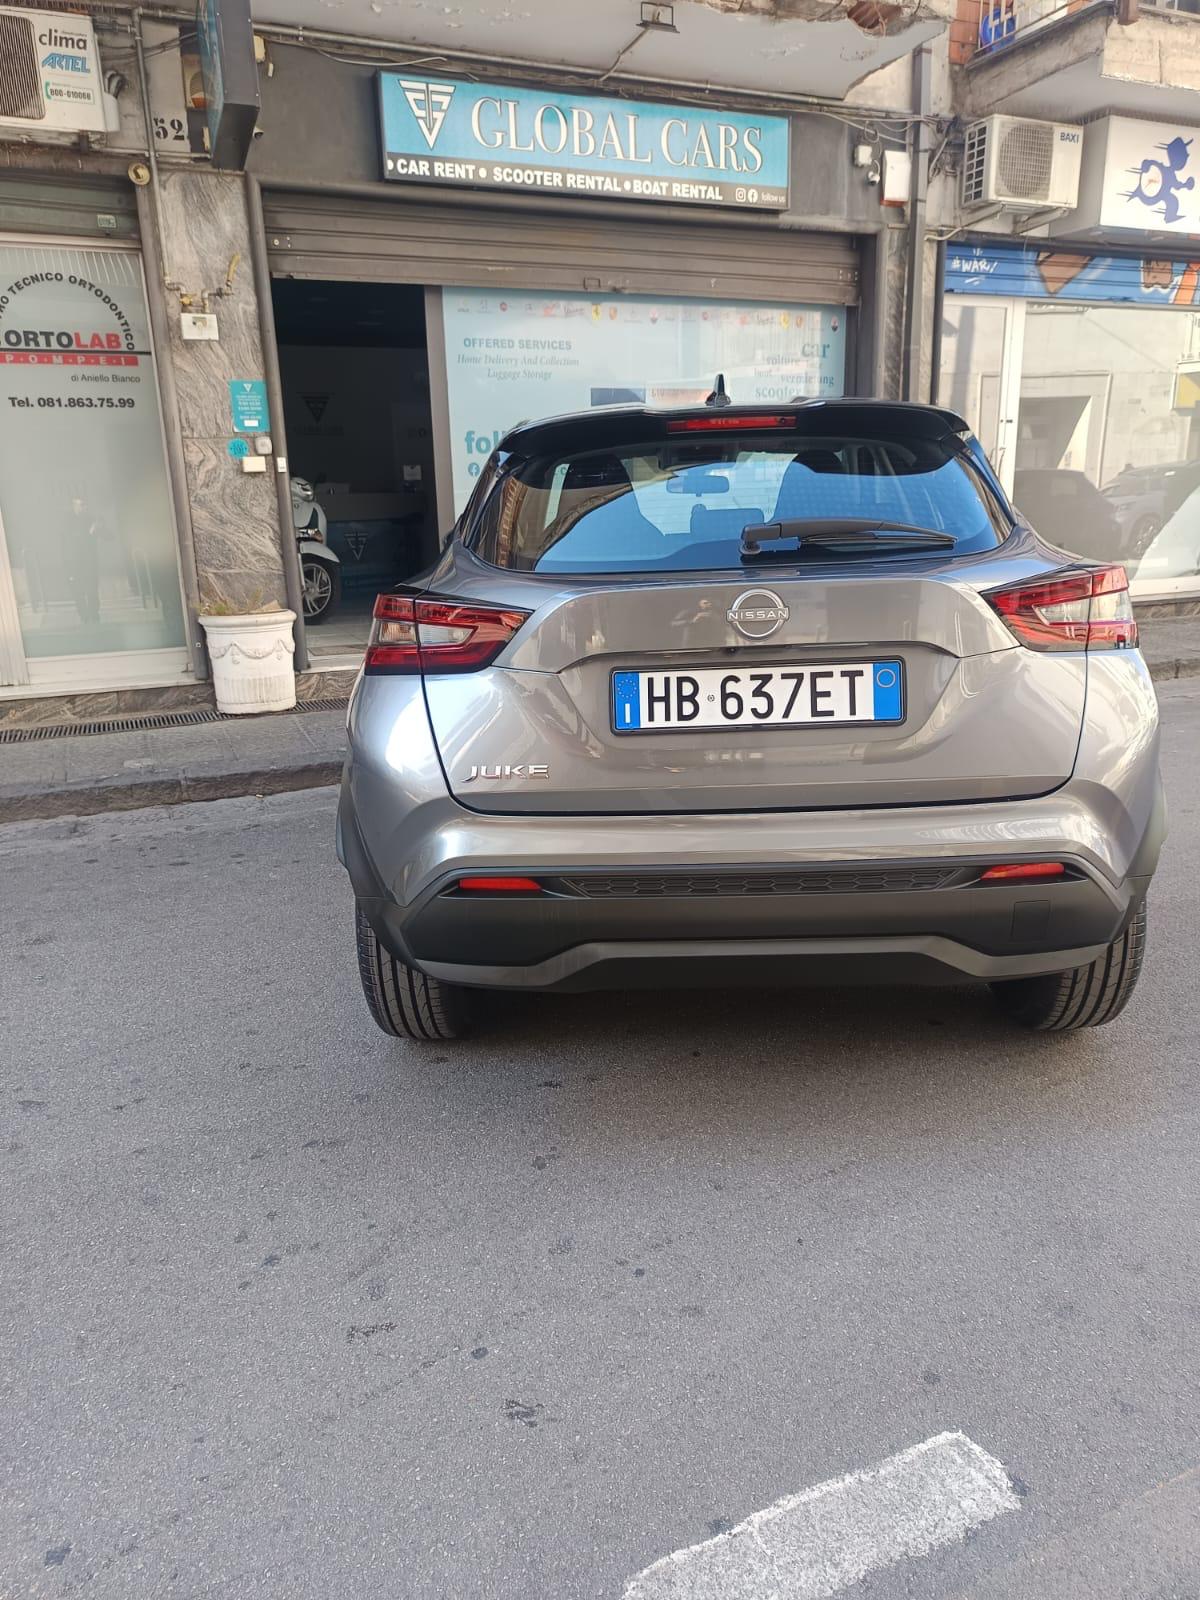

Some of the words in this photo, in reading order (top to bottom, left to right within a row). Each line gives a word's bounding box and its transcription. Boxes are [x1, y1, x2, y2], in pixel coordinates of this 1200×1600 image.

[38, 28, 88, 51] clima
[41, 52, 91, 74] ARTEL
[471, 96, 653, 163] GLOBAL
[661, 117, 764, 175] CARS
[1060, 132, 1079, 144] BAXI
[397, 158, 431, 177] CAR
[433, 161, 476, 180] RENT
[493, 166, 563, 188] SCOOTER
[566, 172, 622, 193] RENTAL
[633, 179, 669, 196] BOAT
[672, 183, 723, 201] RENTAL
[8, 271, 64, 296] TECNICO
[68, 274, 136, 351] ORTODONTICO
[5, 329, 122, 349] ORTOLAB
[463, 337, 515, 349] OFFERED
[518, 338, 573, 351] SERVICES
[801, 343, 831, 358] car
[457, 353, 481, 365] Home
[484, 354, 520, 367] Delivery
[521, 355, 538, 366] And
[539, 356, 580, 367] Collection
[71, 374, 79, 383] di
[81, 374, 110, 383] Aniello
[112, 374, 141, 384] Bianco
[487, 367, 521, 381] Luggage
[522, 368, 553, 381] Storage
[8, 396, 34, 408] Tel.
[37, 397, 136, 409] 081.863.75.99
[728, 608, 788, 620] NISSAN
[647, 674, 700, 723] HB
[720, 669, 865, 721] 637ET
[460, 764, 551, 784] JUKE
